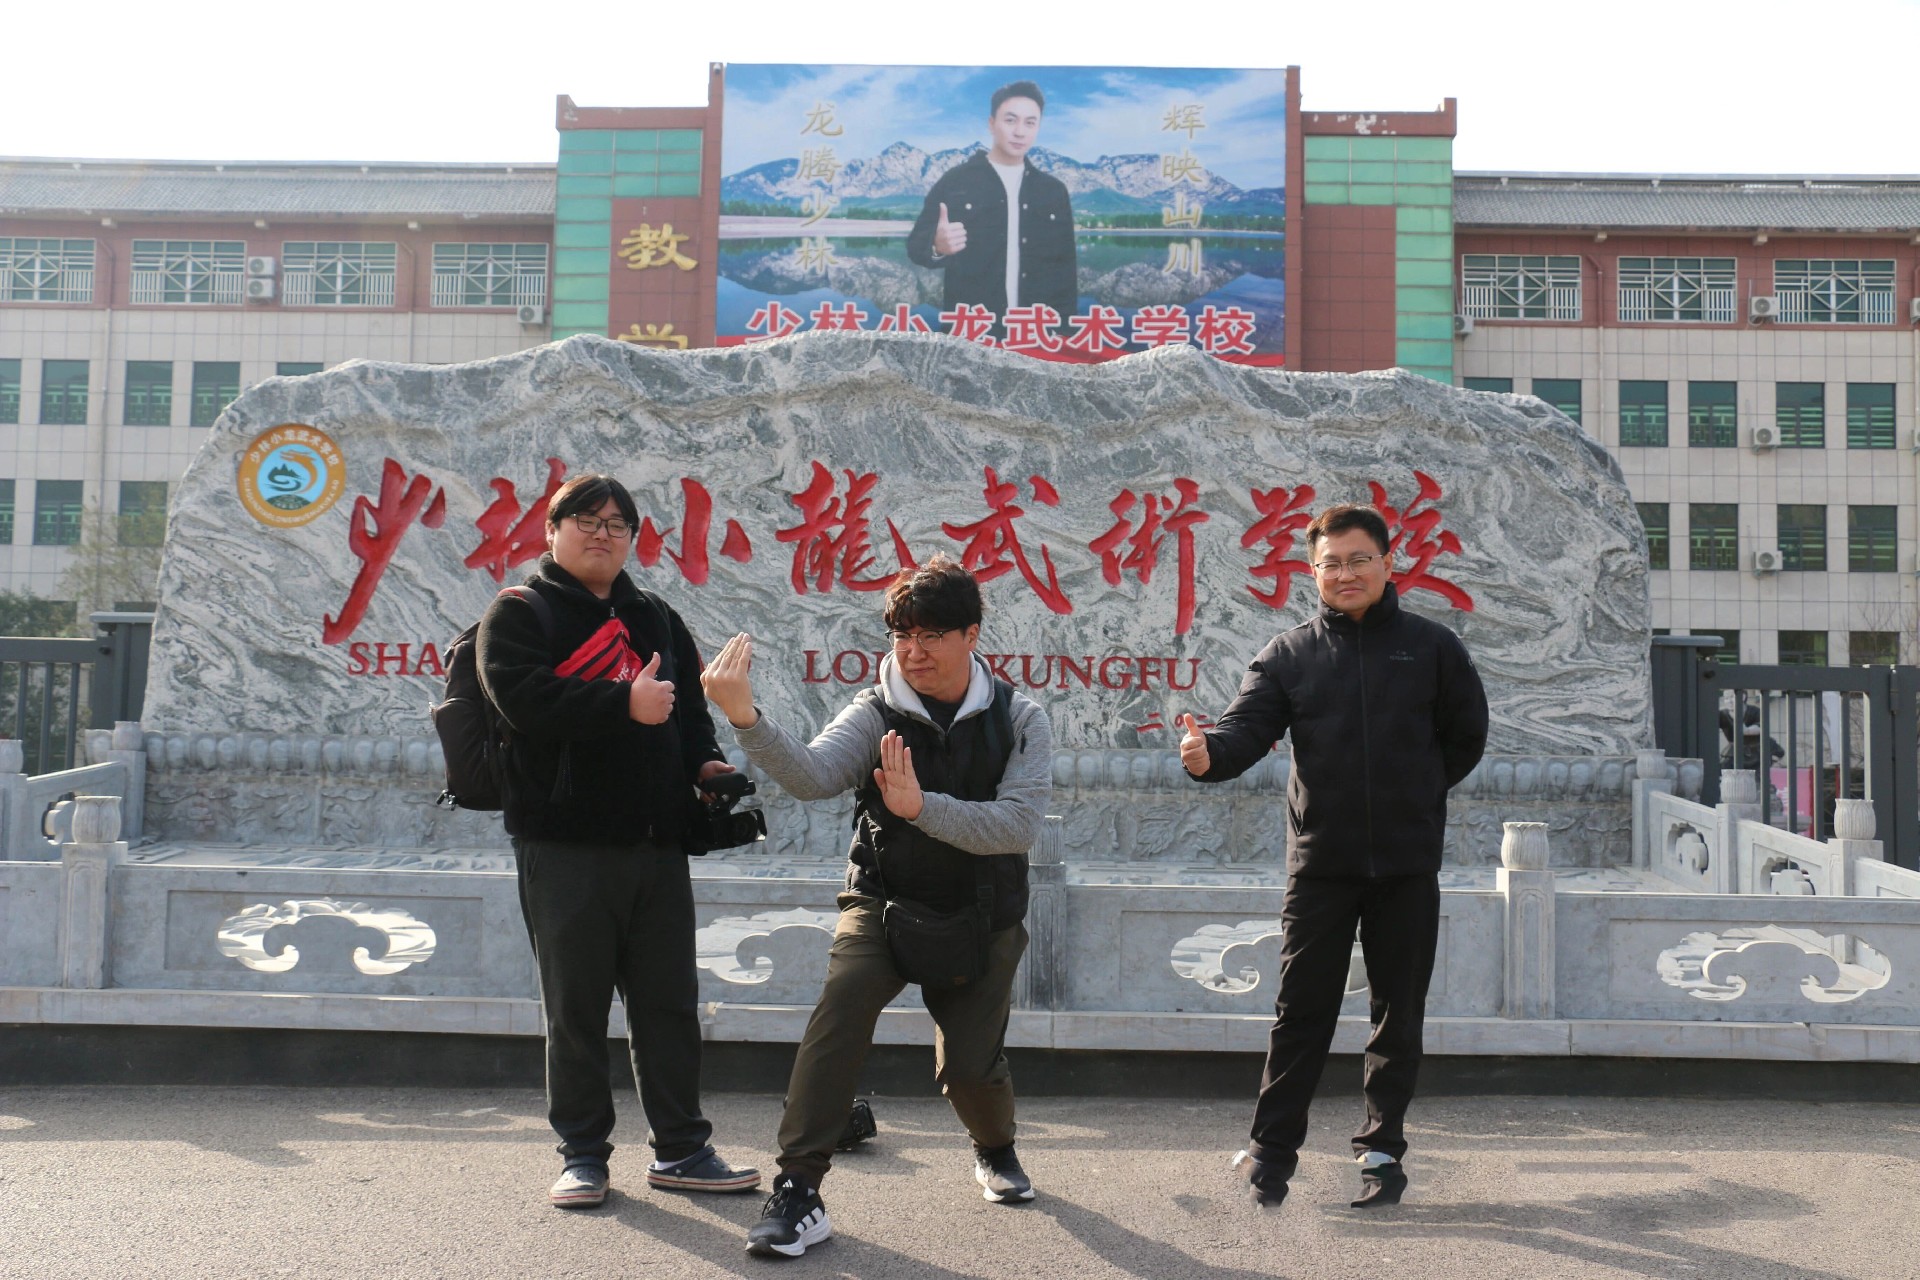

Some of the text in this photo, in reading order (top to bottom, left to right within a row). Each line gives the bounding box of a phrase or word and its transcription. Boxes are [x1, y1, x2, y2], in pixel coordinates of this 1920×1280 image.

[797, 103, 843, 273] 龙腾少林
[1162, 104, 1205, 276] 辉映山川
[745, 301, 1256, 354] 少林小龙武术学校
[982, 653, 1202, 691] KUNGFU
